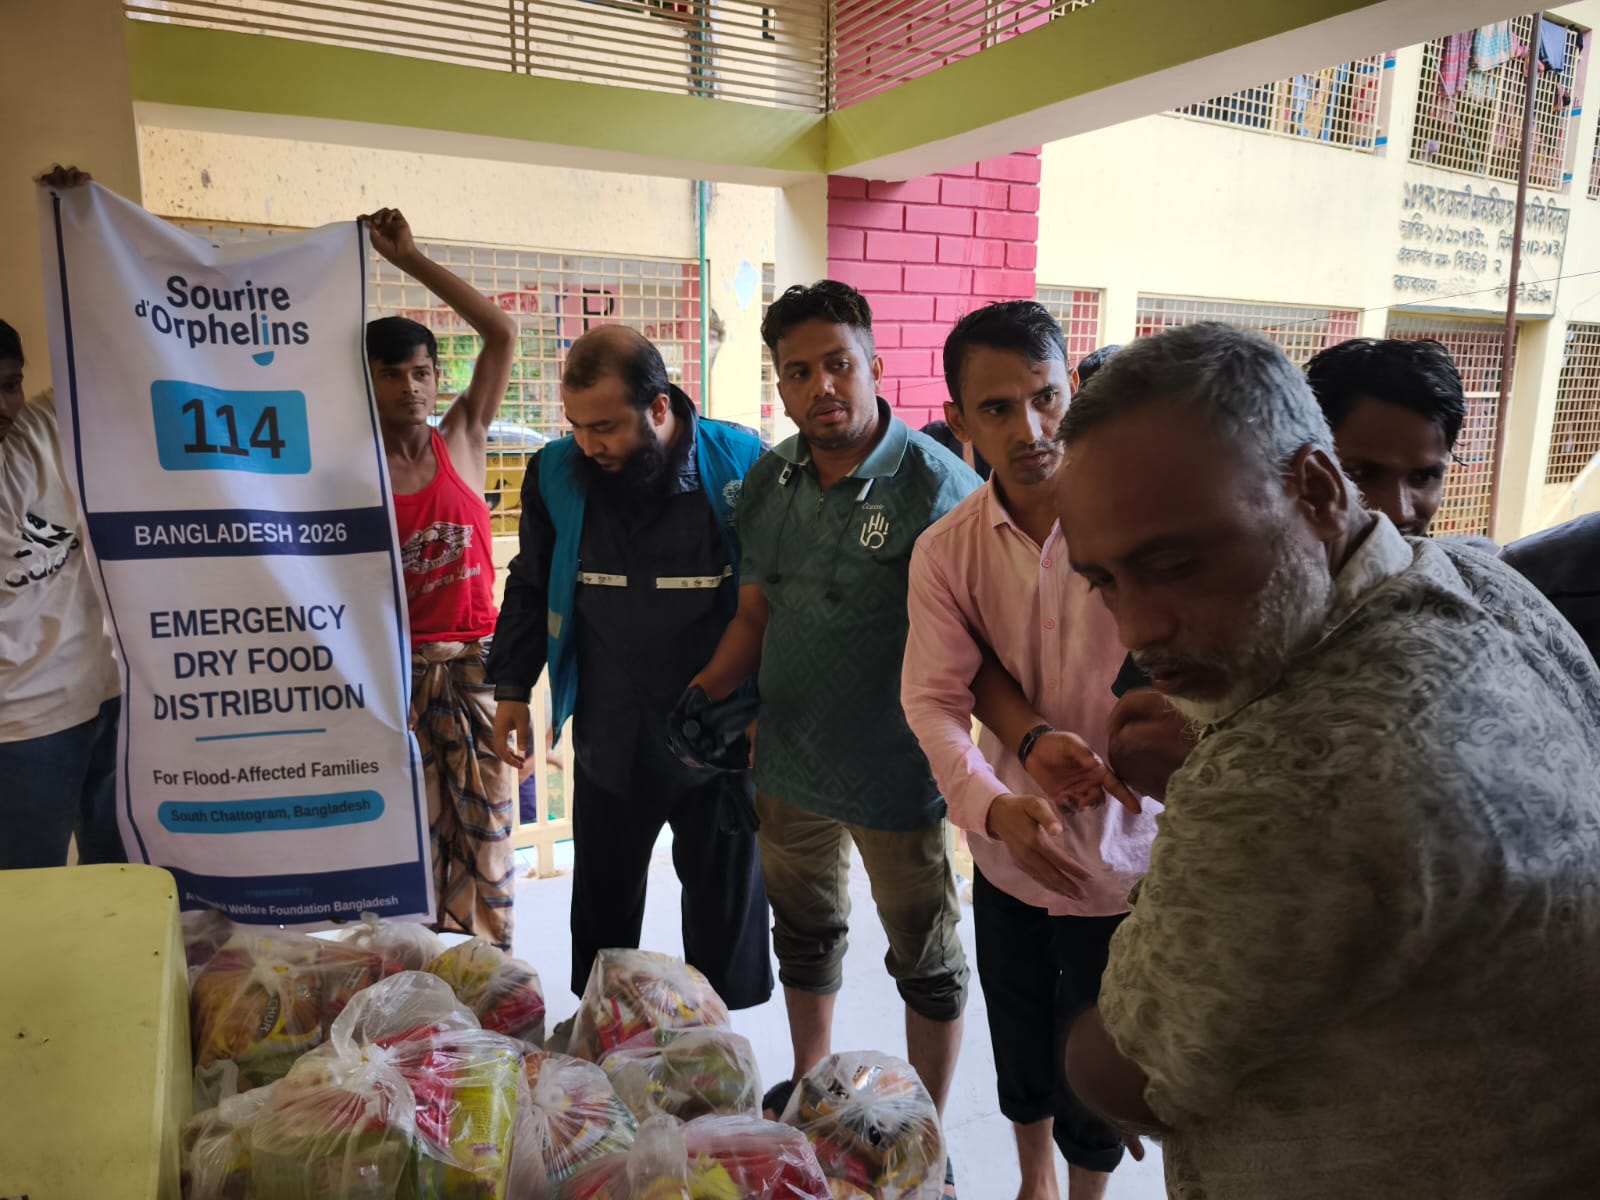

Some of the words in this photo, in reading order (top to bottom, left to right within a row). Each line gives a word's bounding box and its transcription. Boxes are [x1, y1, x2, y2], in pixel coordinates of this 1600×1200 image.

[166, 275, 291, 312] Sourire
[135, 299, 310, 349] d'Orphelins
[182, 398, 286, 459] 114
[134, 522, 293, 546] BANGLADESH
[298, 523, 348, 544] 2026
[150, 604, 346, 639] EMERGENCY
[173, 649, 238, 679] DRY
[247, 645, 334, 674] FOOD
[153, 683, 366, 721] DISTRIBUTION
[153, 769, 179, 786] For
[183, 763, 306, 786] Flood-Affected
[311, 759, 379, 778] Families
[170, 809, 208, 823] South
[210, 808, 291, 824] Chattogram,
[293, 799, 371, 820] Bangladesh
[228, 903, 268, 915] Welfare
[269, 901, 333, 916] Foundation
[334, 895, 399, 912] Bangladesh
